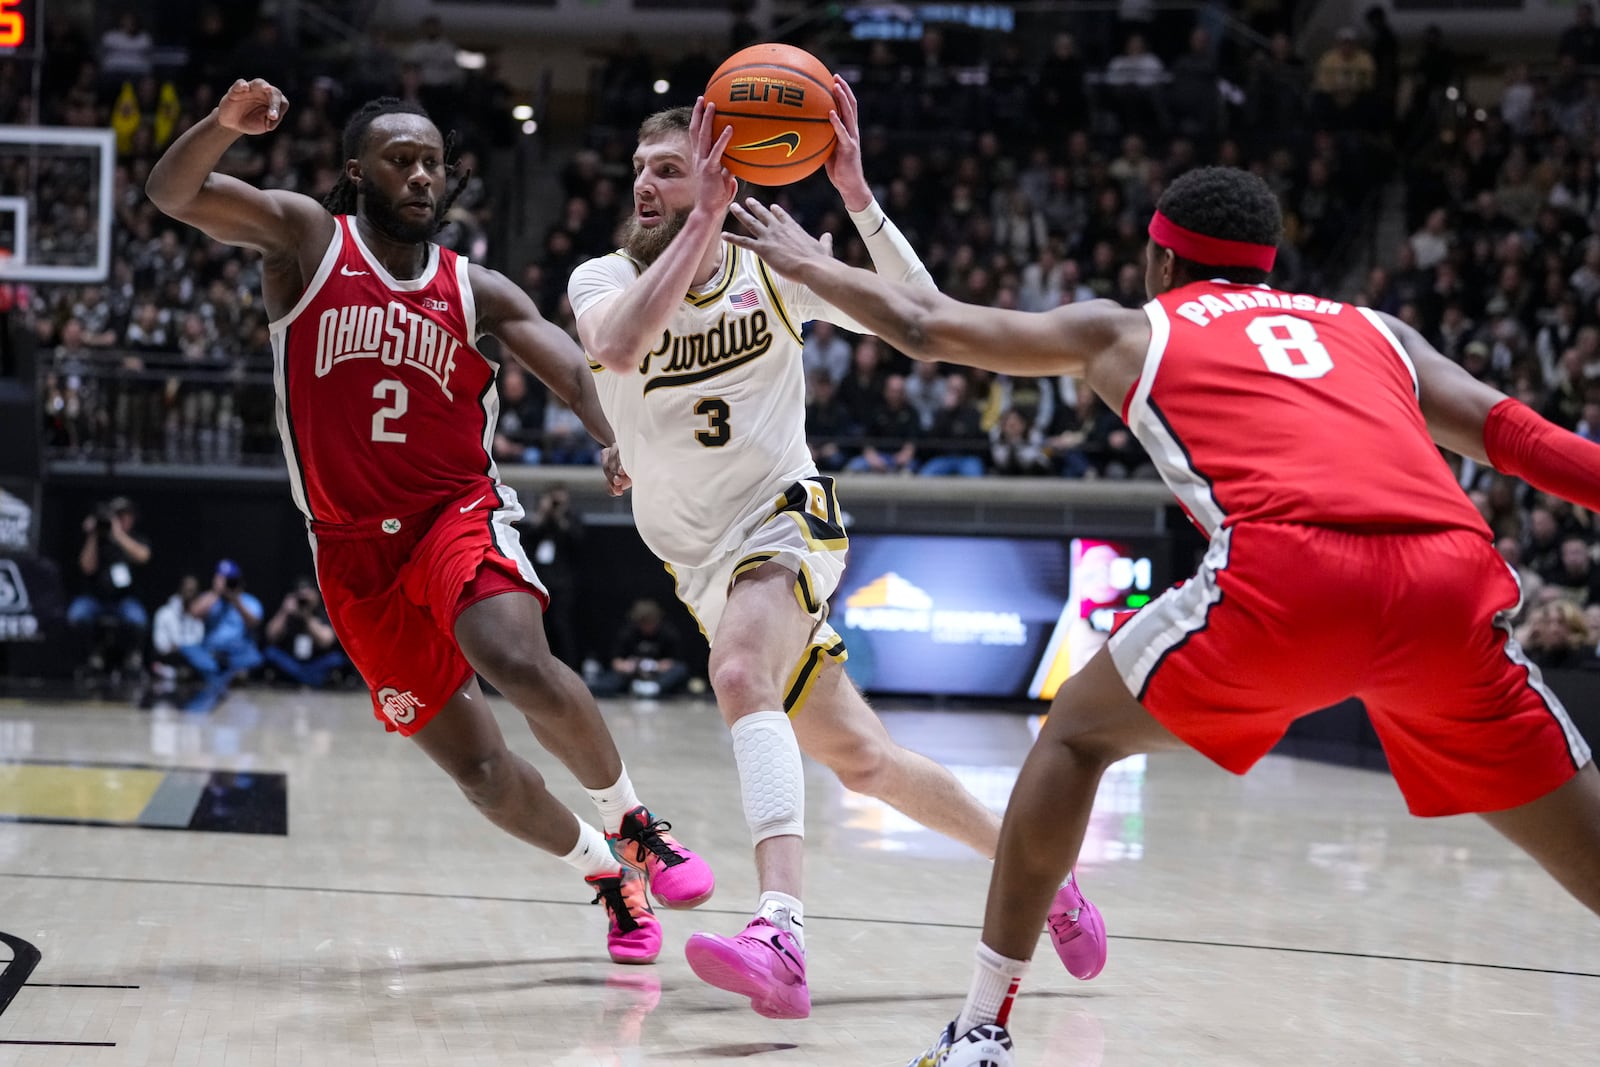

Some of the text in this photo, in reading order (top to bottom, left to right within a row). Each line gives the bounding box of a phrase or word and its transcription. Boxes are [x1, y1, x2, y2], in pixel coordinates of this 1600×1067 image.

[729, 83, 805, 108] ELITE
[315, 300, 463, 402] OHIO STATE
[1245, 314, 1335, 379] 8
[371, 379, 409, 443] 2
[693, 397, 731, 447] 3
